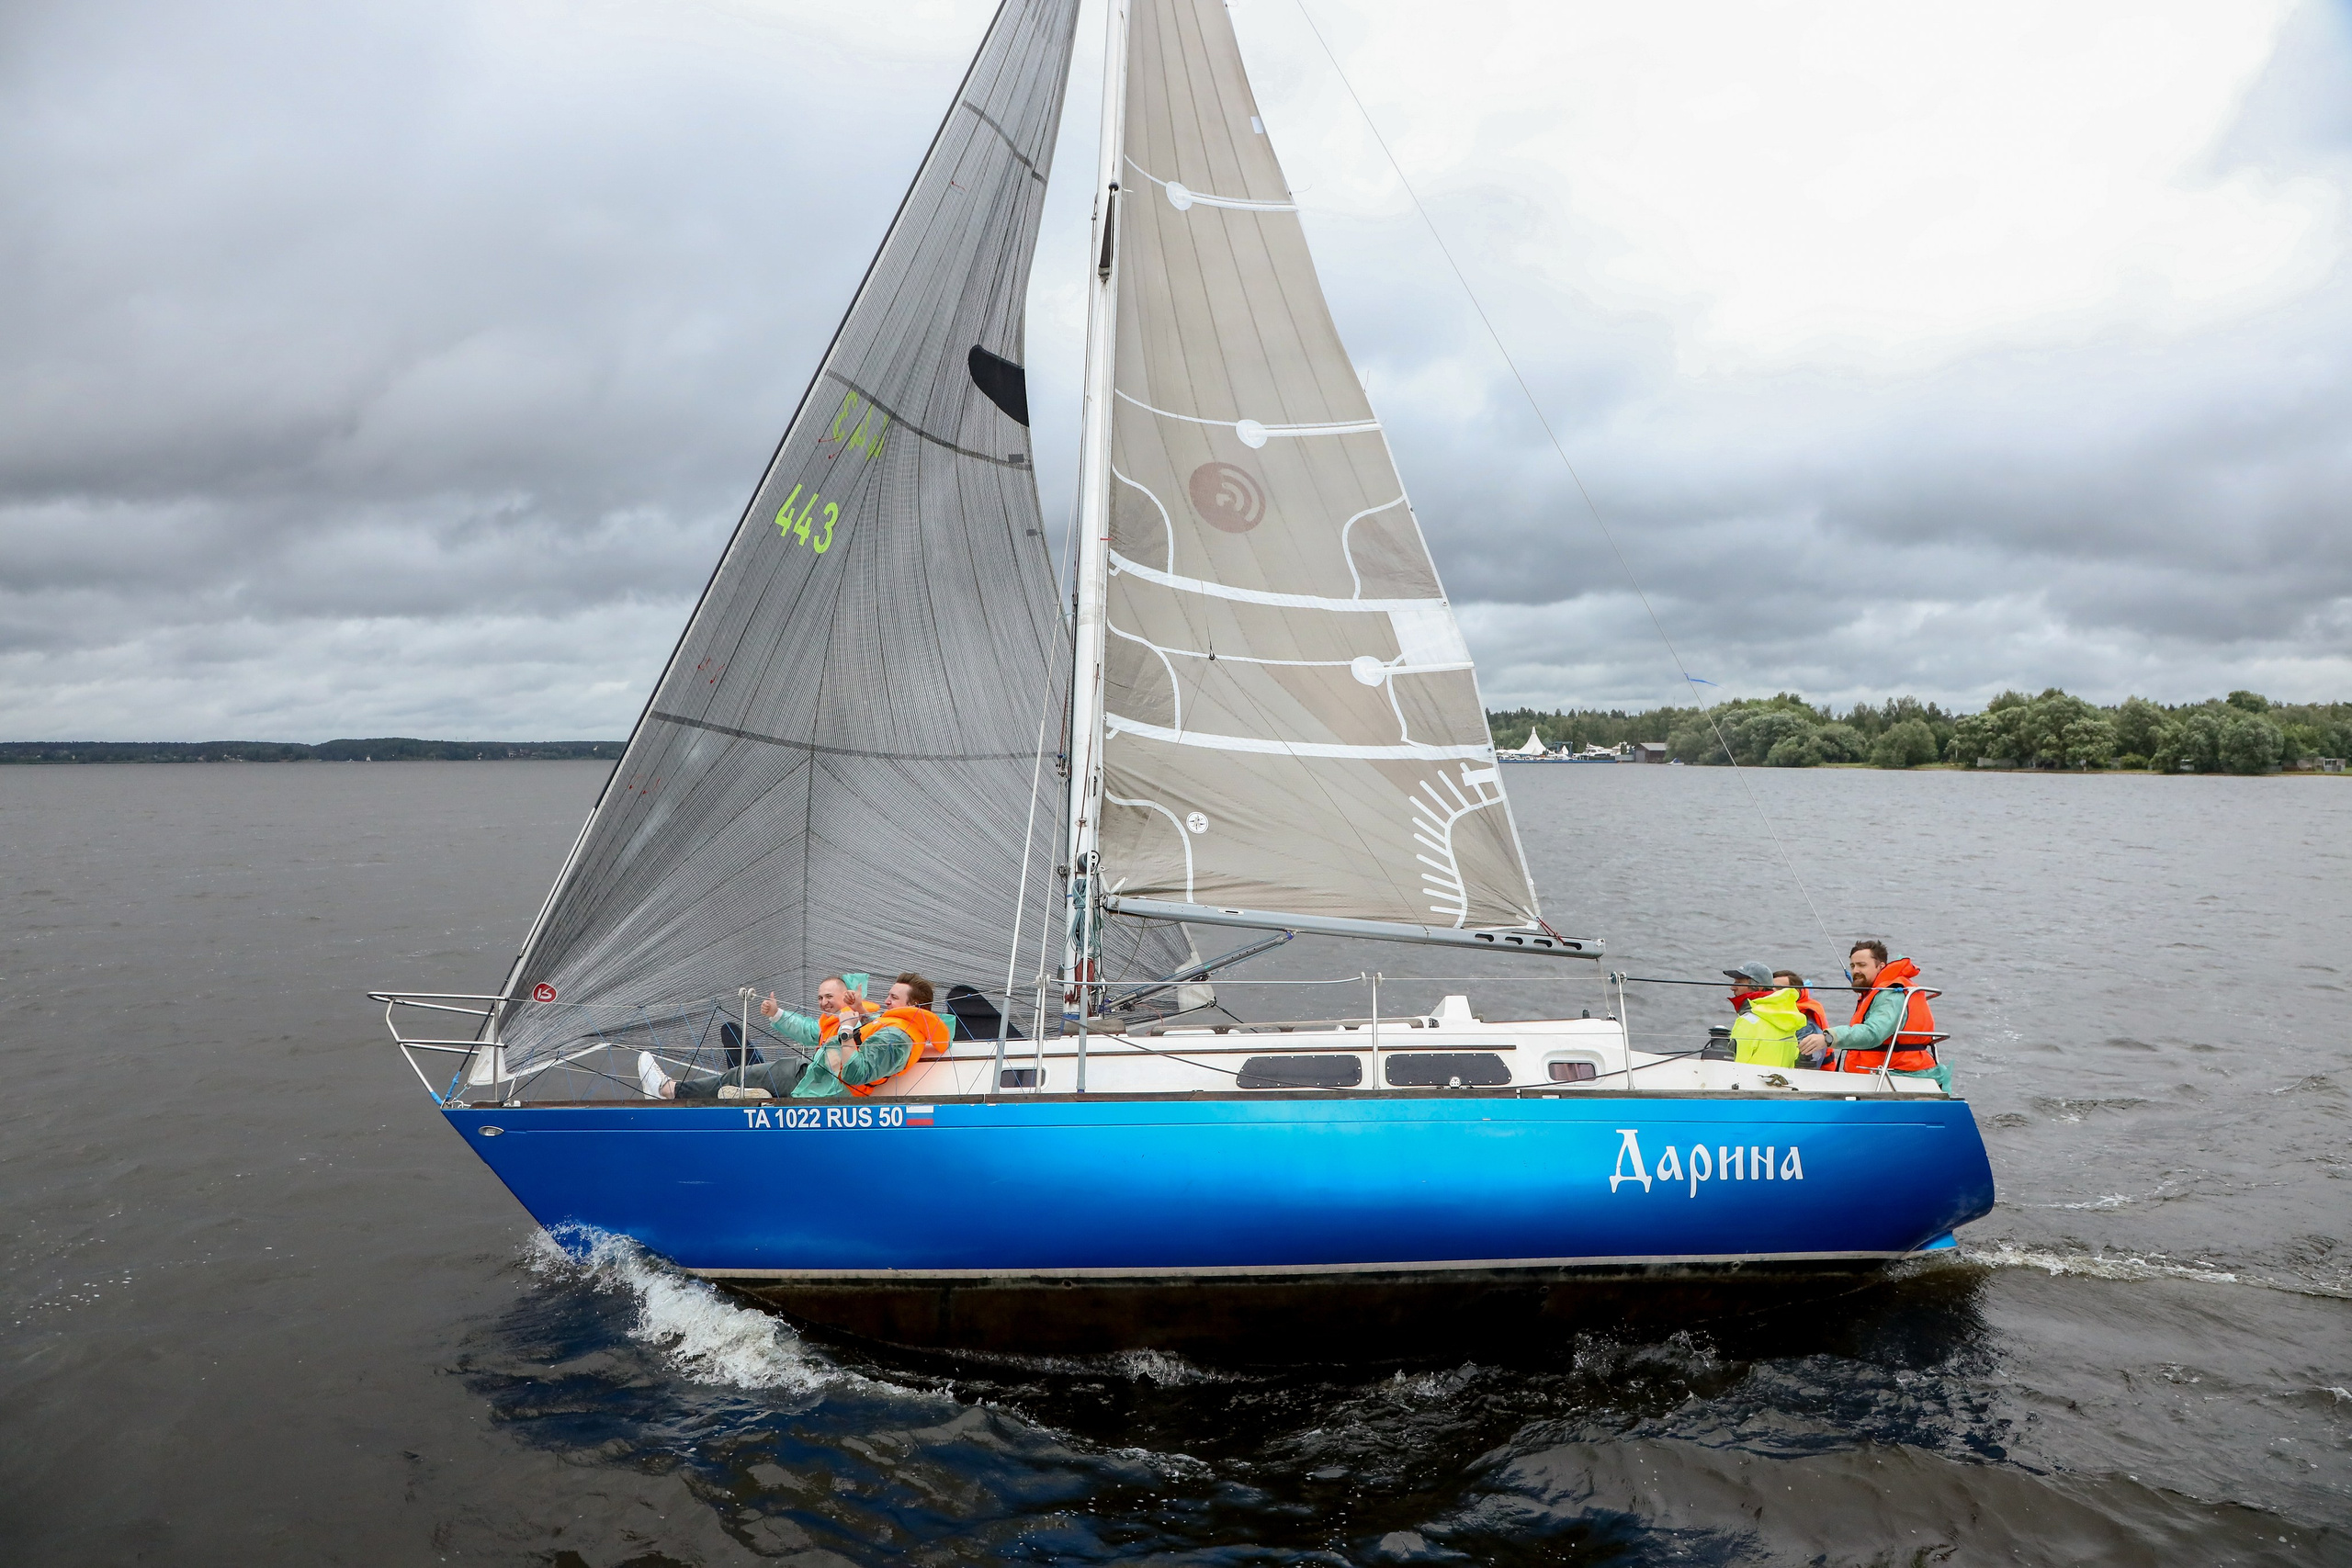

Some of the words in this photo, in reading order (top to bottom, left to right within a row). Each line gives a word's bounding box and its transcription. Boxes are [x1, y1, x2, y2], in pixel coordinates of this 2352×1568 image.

[775, 484, 840, 554] 443
[743, 1109, 771, 1129] TA
[775, 1108, 821, 1129] 1022
[826, 1107, 873, 1128] RUS
[878, 1106, 903, 1127] 50
[1609, 1129, 1804, 1199] Дарина
